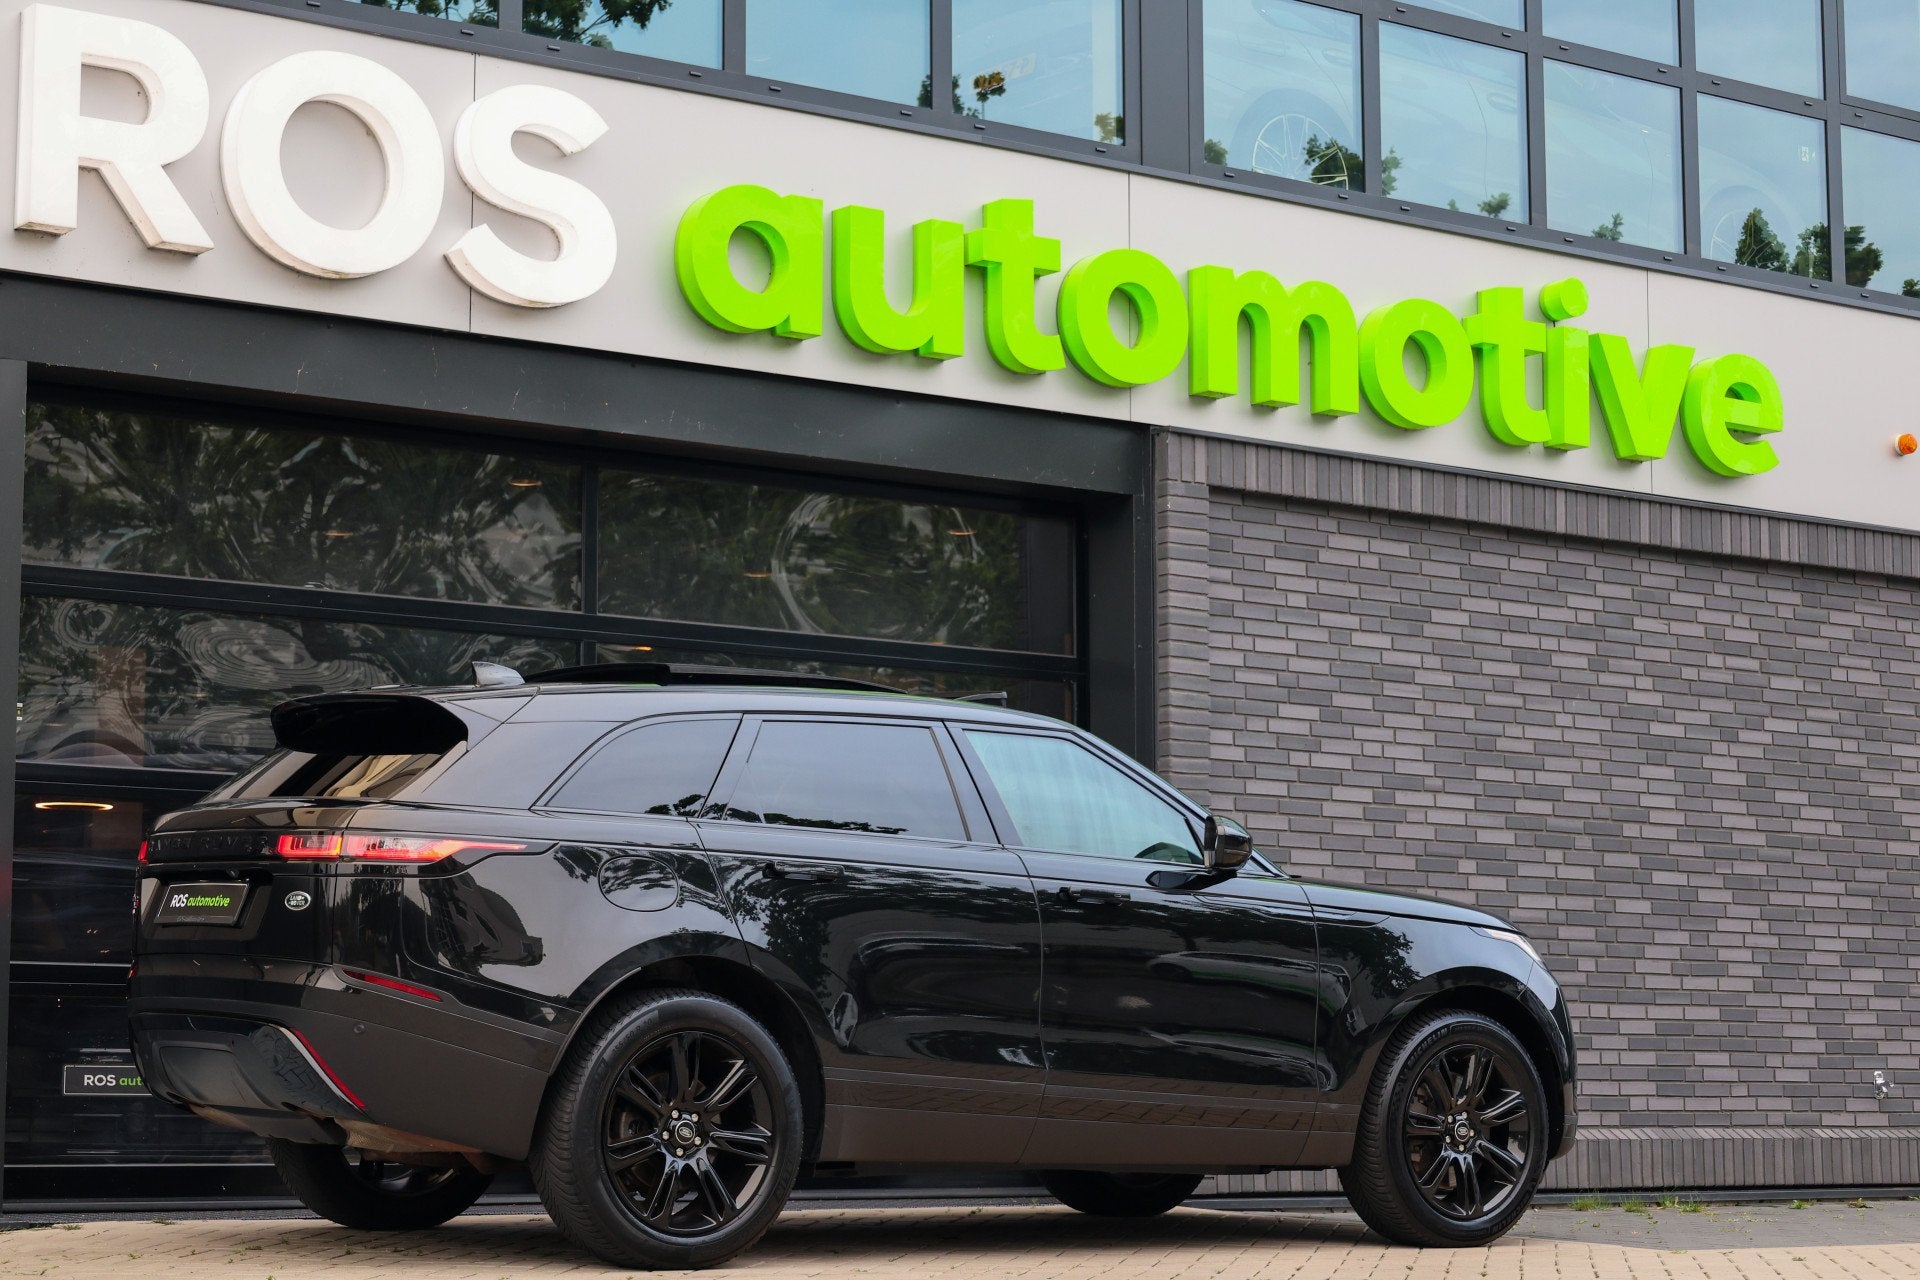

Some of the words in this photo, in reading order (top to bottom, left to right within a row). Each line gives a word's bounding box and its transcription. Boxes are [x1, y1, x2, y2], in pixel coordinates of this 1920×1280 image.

[15, 3, 617, 309] ROS
[675, 183, 1784, 478] automotive
[170, 894, 187, 908] ROS
[187, 894, 230, 907] automotive
[84, 1074, 116, 1087] ROS
